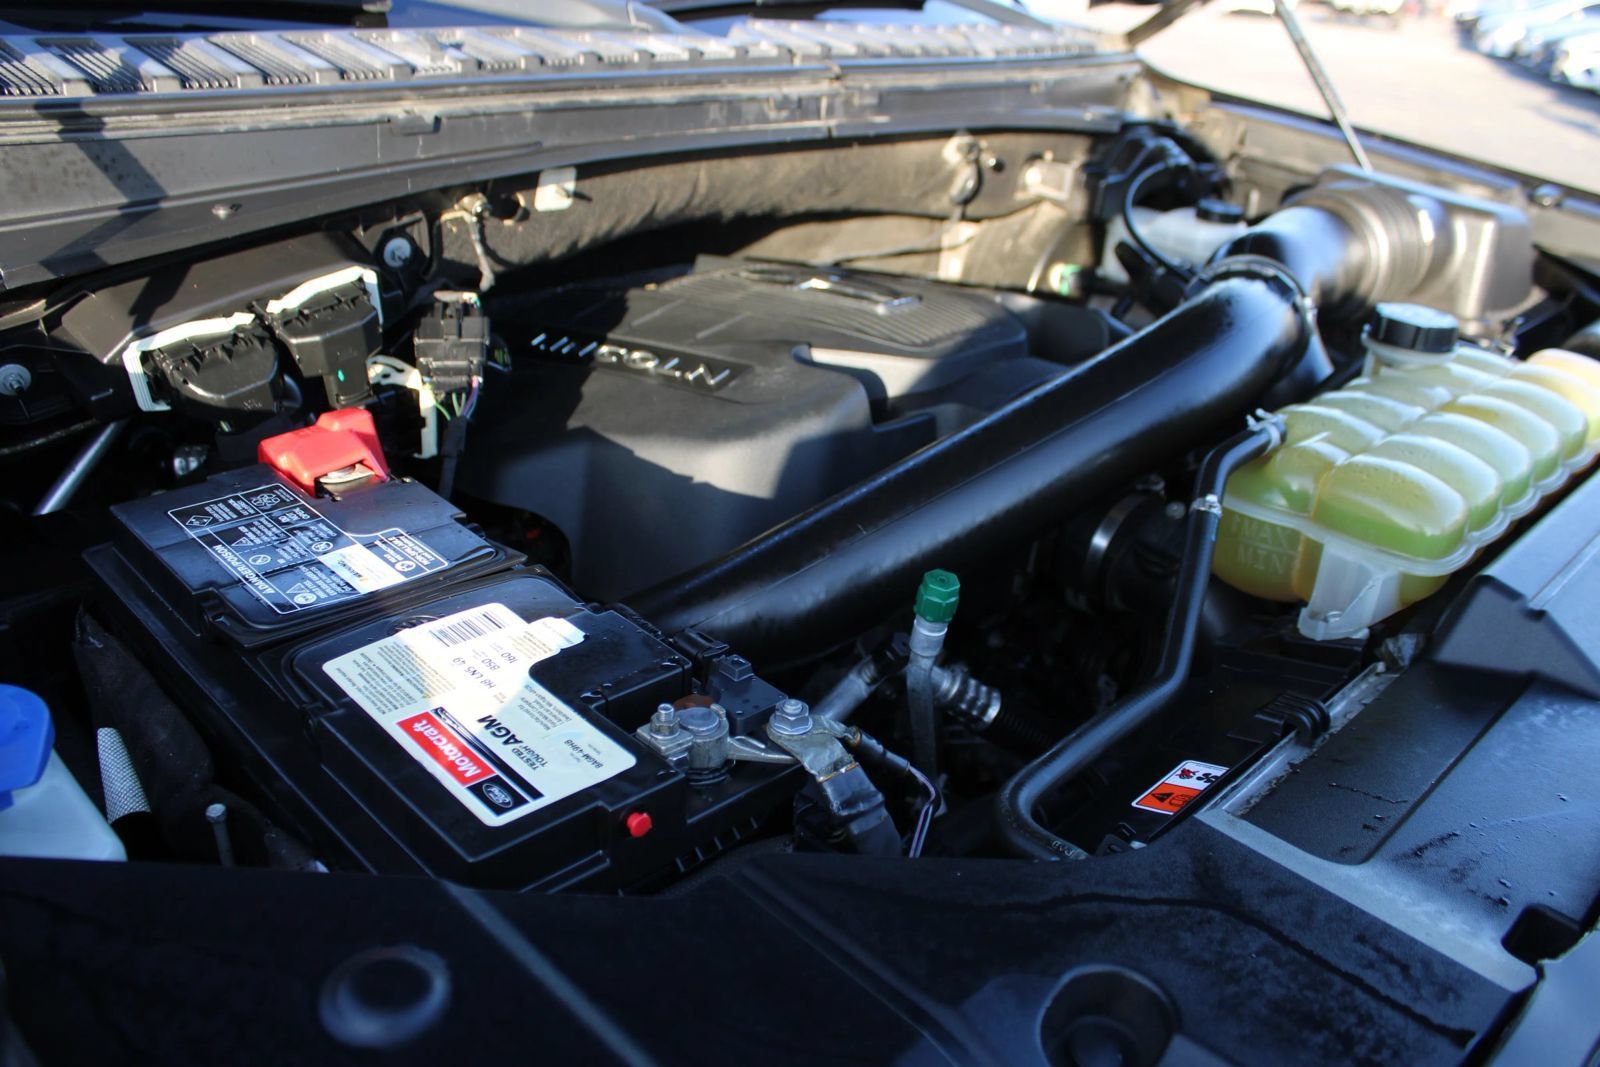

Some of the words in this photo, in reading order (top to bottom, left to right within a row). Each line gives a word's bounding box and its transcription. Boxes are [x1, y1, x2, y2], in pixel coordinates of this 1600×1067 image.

[479, 656, 502, 671] 850
[498, 650, 519, 664] 160
[474, 713, 524, 749] AGM
[408, 718, 483, 778] Motorcraft
[509, 746, 541, 771] TESTED
[482, 783, 513, 807] Ford
